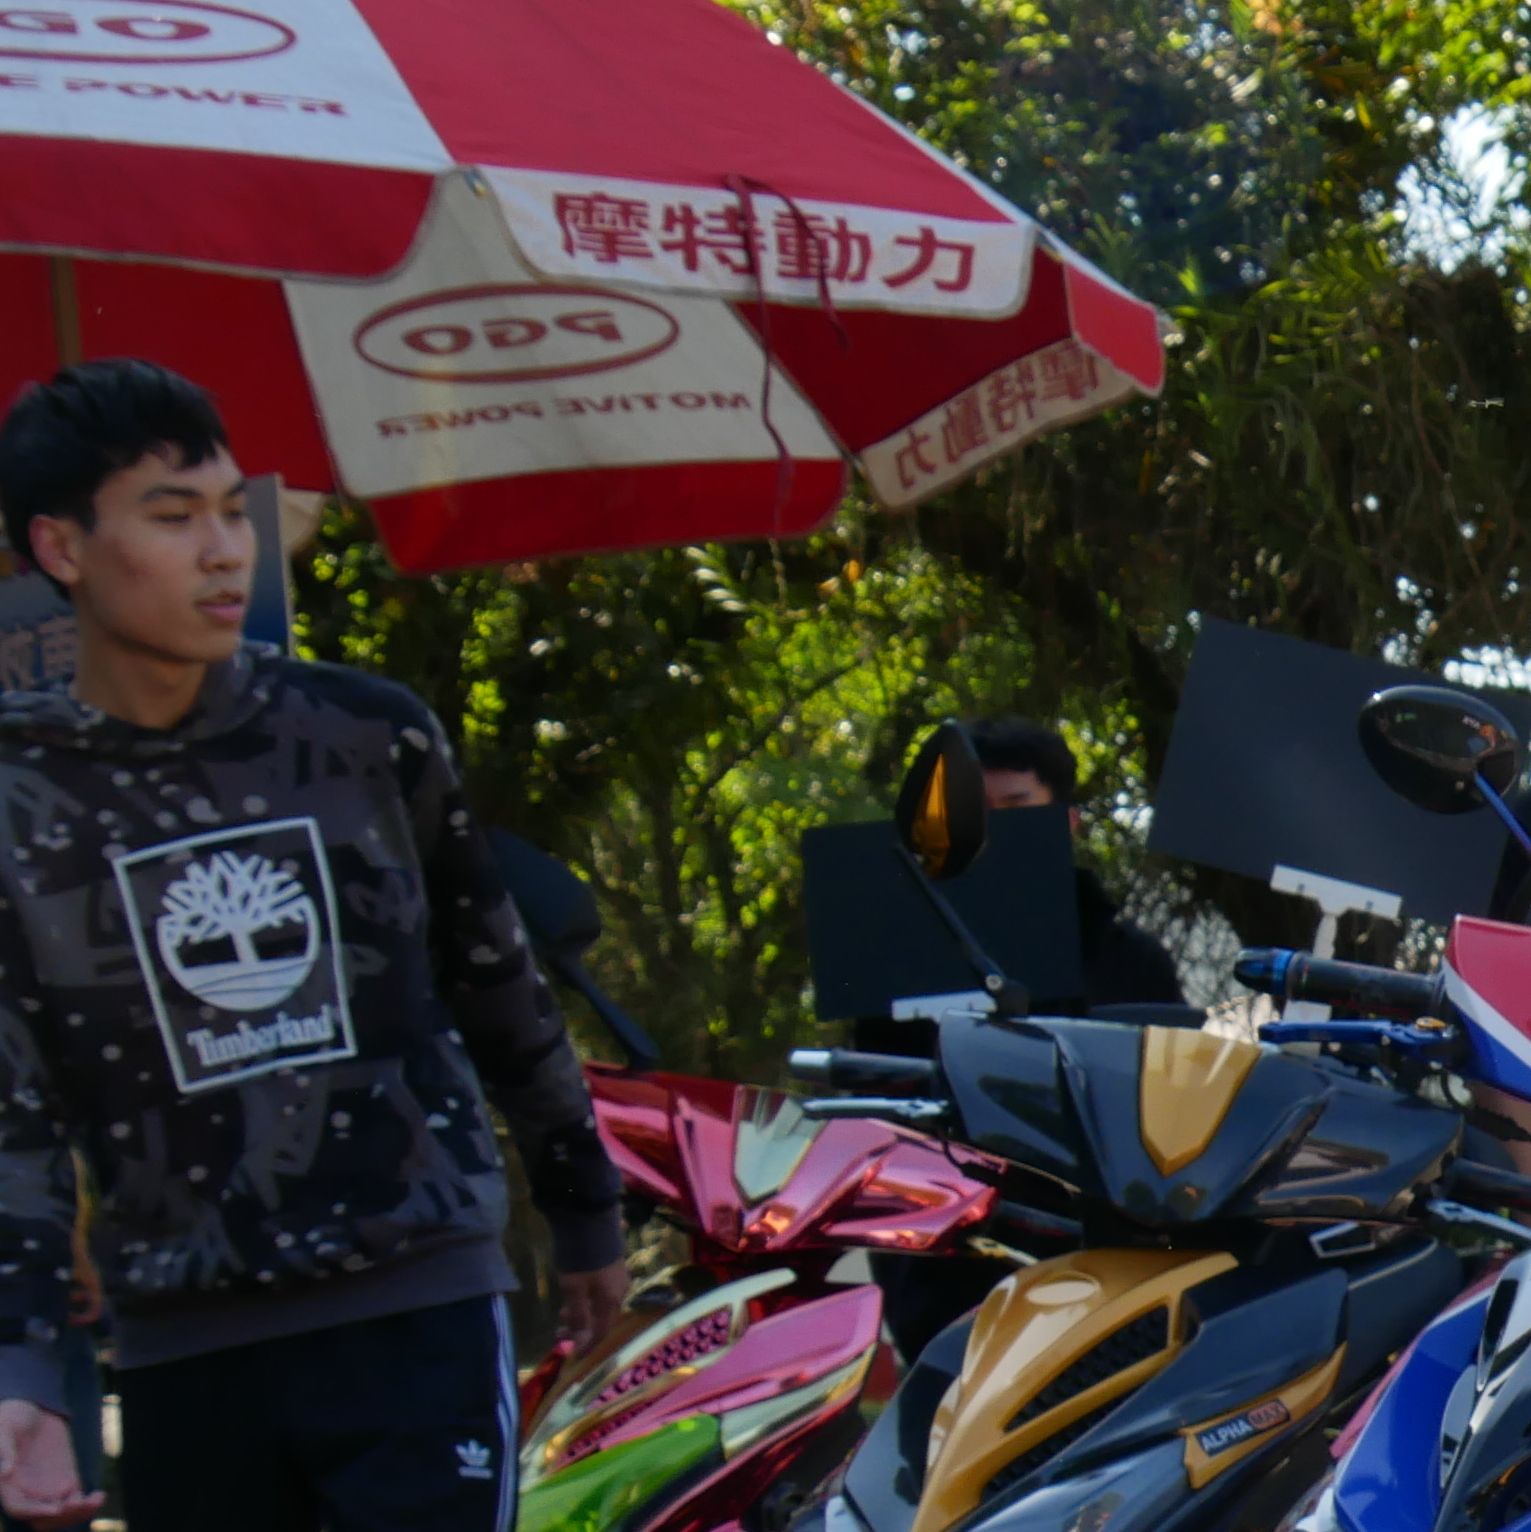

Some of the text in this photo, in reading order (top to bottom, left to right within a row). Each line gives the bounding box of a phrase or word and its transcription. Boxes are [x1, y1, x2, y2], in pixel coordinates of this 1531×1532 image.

[63, 76, 348, 117] POWER
[554, 190, 976, 293] 摩特動力
[186, 1003, 335, 1067] Timberland
[1201, 1418, 1254, 1452] ALPHA
